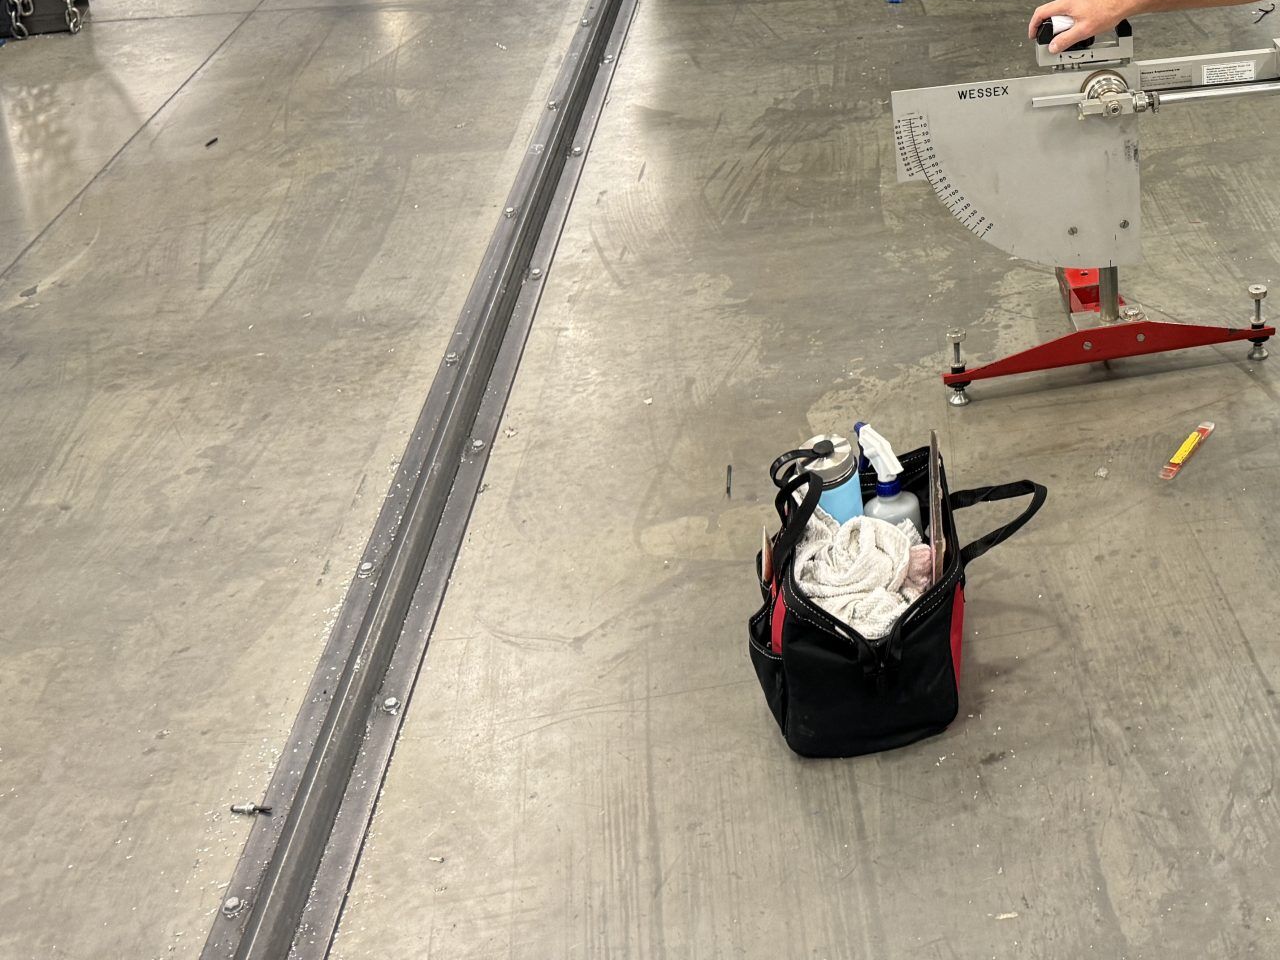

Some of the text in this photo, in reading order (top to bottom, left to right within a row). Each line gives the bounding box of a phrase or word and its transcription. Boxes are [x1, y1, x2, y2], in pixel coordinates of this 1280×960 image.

[958, 86, 1008, 100] WESSEX
[961, 203, 971, 211] 120
[968, 210, 978, 218] 130
[976, 216, 985, 225] 140
[985, 223, 994, 232] 150
